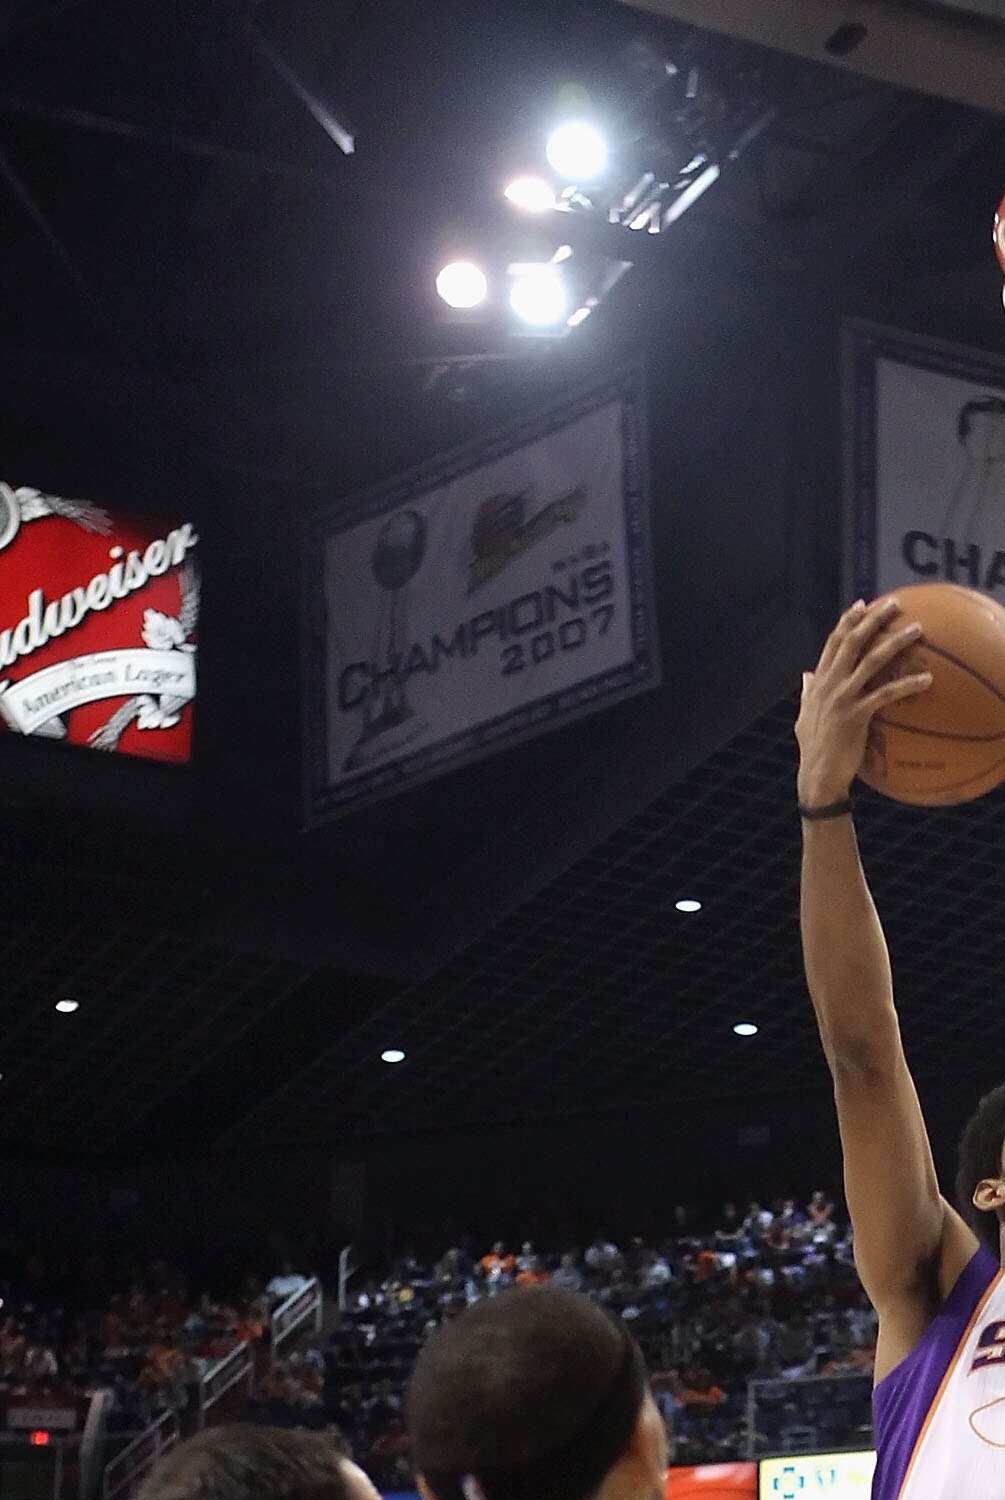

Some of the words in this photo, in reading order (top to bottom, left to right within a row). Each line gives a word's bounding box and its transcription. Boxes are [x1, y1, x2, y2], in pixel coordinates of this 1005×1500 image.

[337, 560, 615, 712] CHAMPIONS
[501, 603, 616, 677] 2007
[125, 663, 185, 688] Lager
